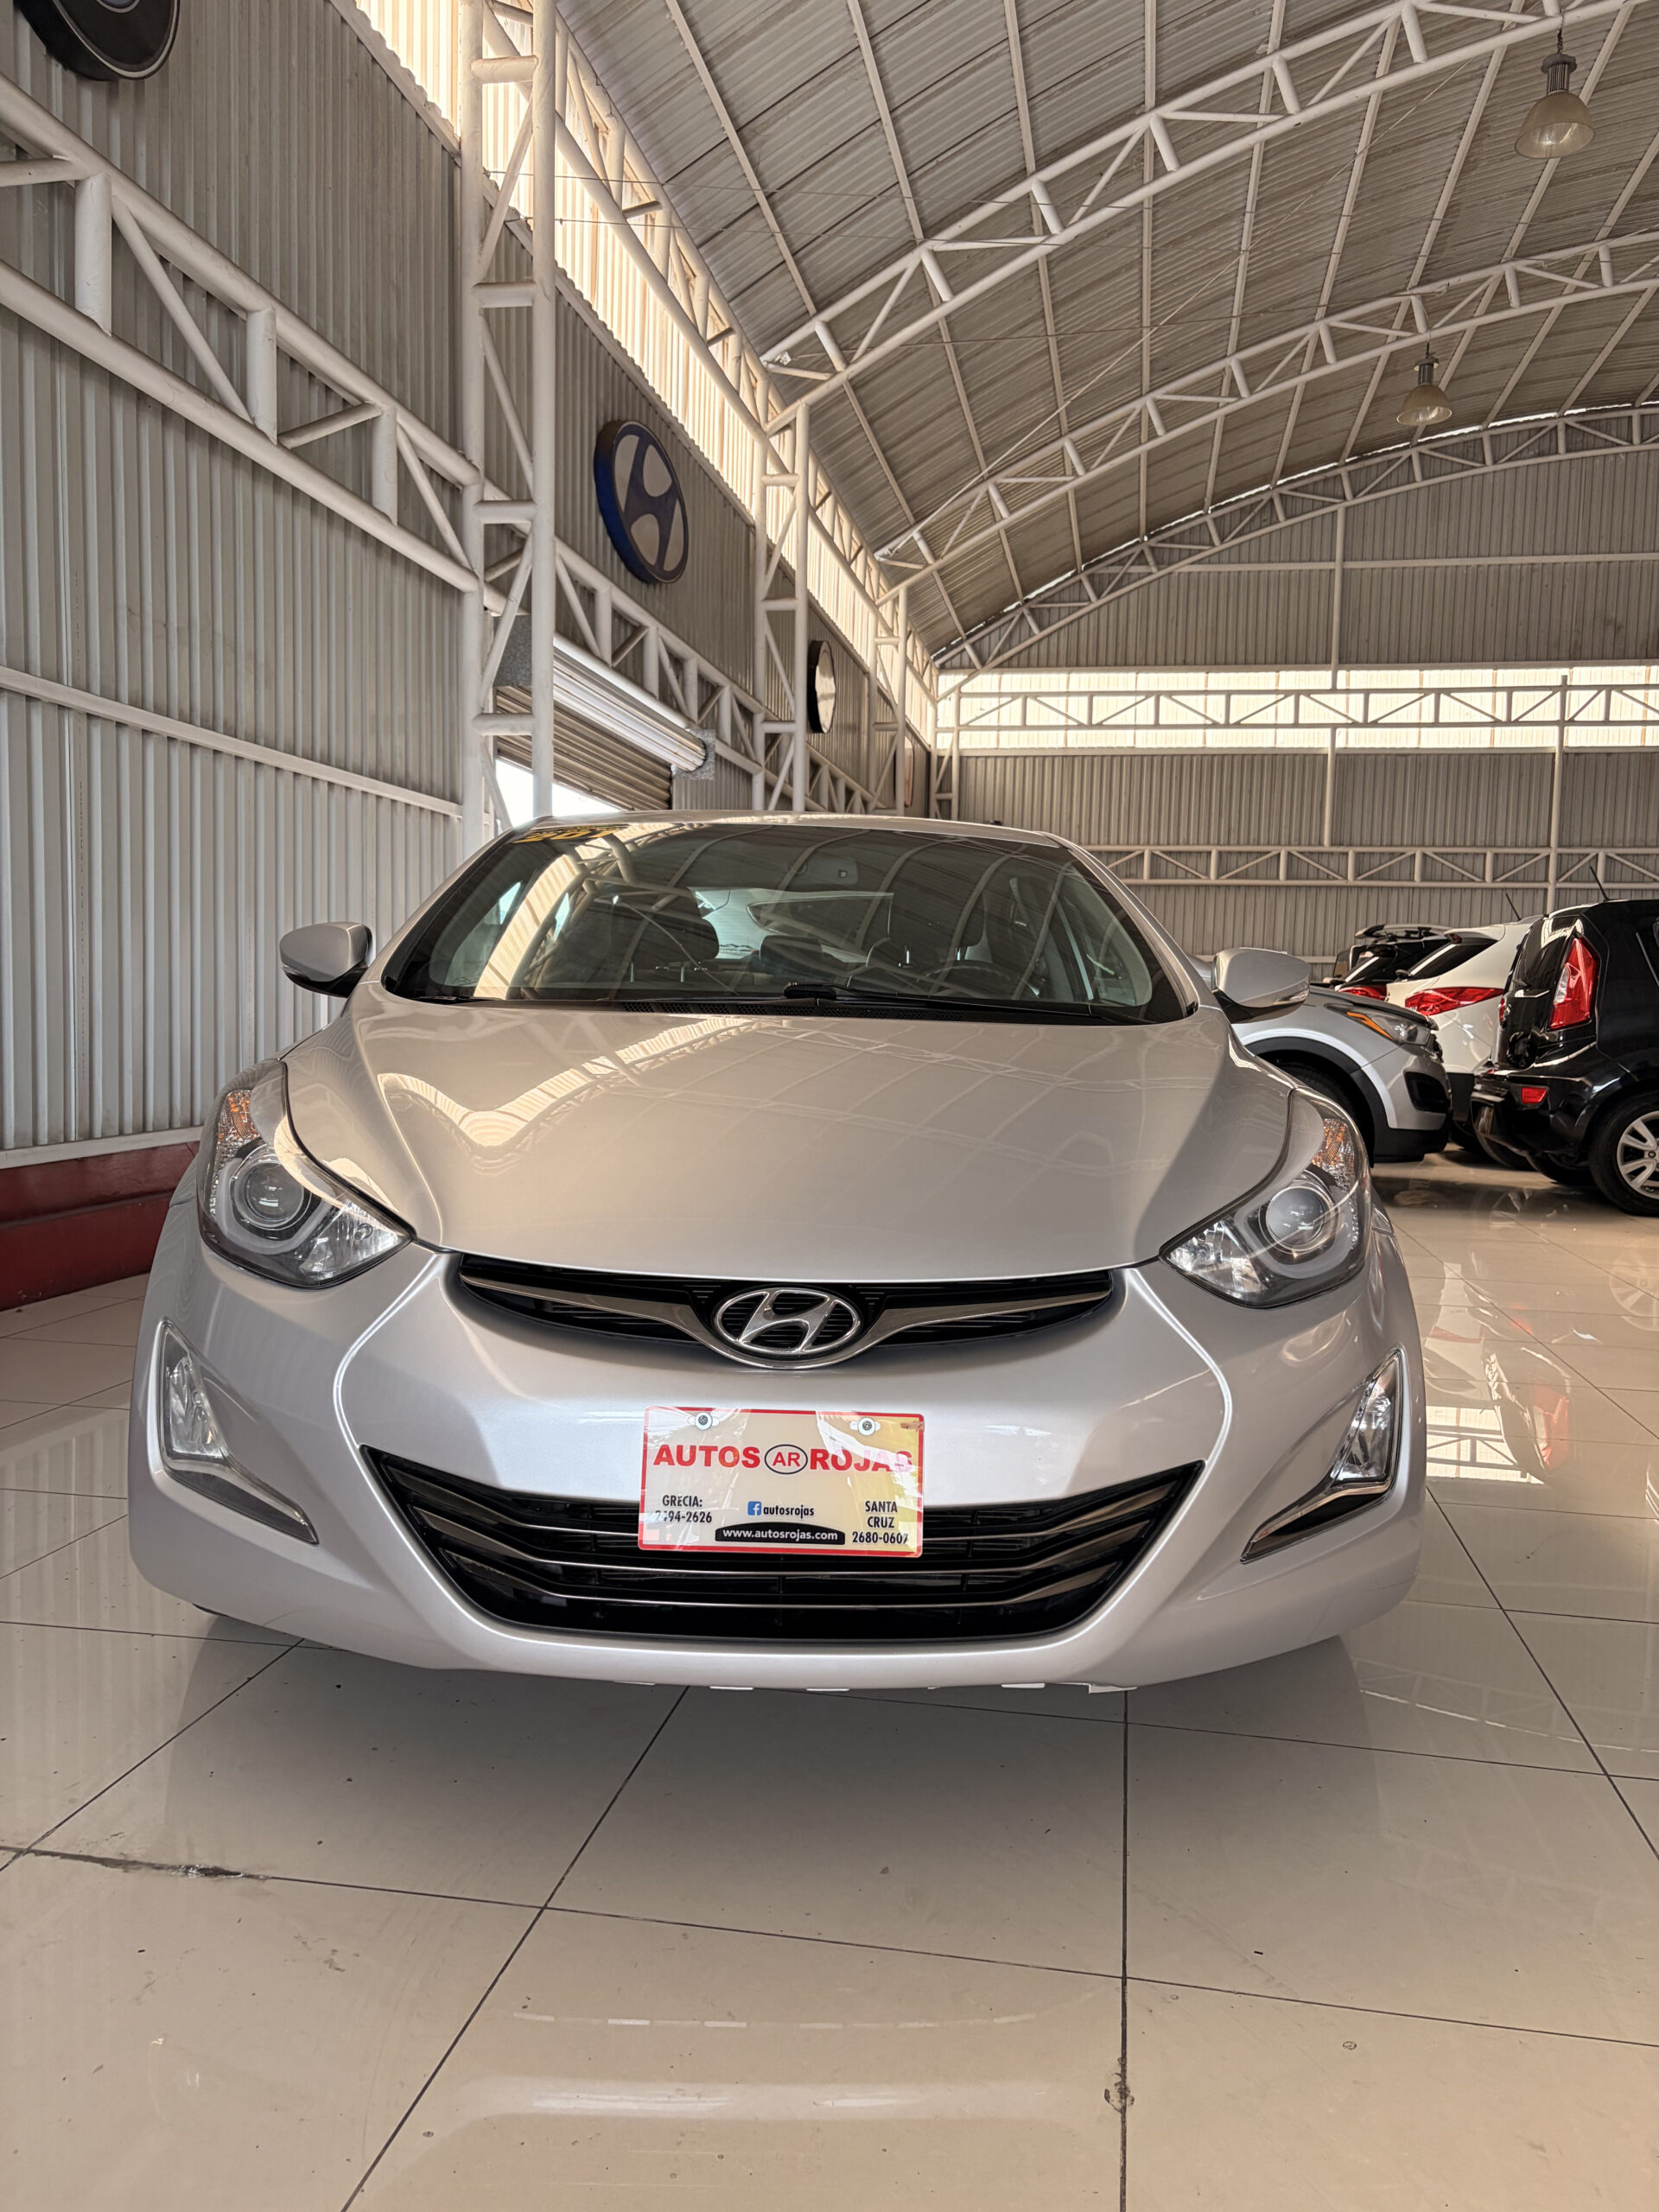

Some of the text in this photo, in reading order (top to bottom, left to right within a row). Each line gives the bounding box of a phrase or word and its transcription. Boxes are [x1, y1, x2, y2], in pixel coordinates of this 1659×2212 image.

[653, 1444, 912, 1472] AUTOS AR ROJAS
[662, 1495, 702, 1508] GRECIA:
[865, 1501, 898, 1513] SANTA
[763, 1504, 815, 1519] autosrojas
[867, 1516, 895, 1529] CRUZ
[722, 1529, 838, 1541] www.autosrojas.com
